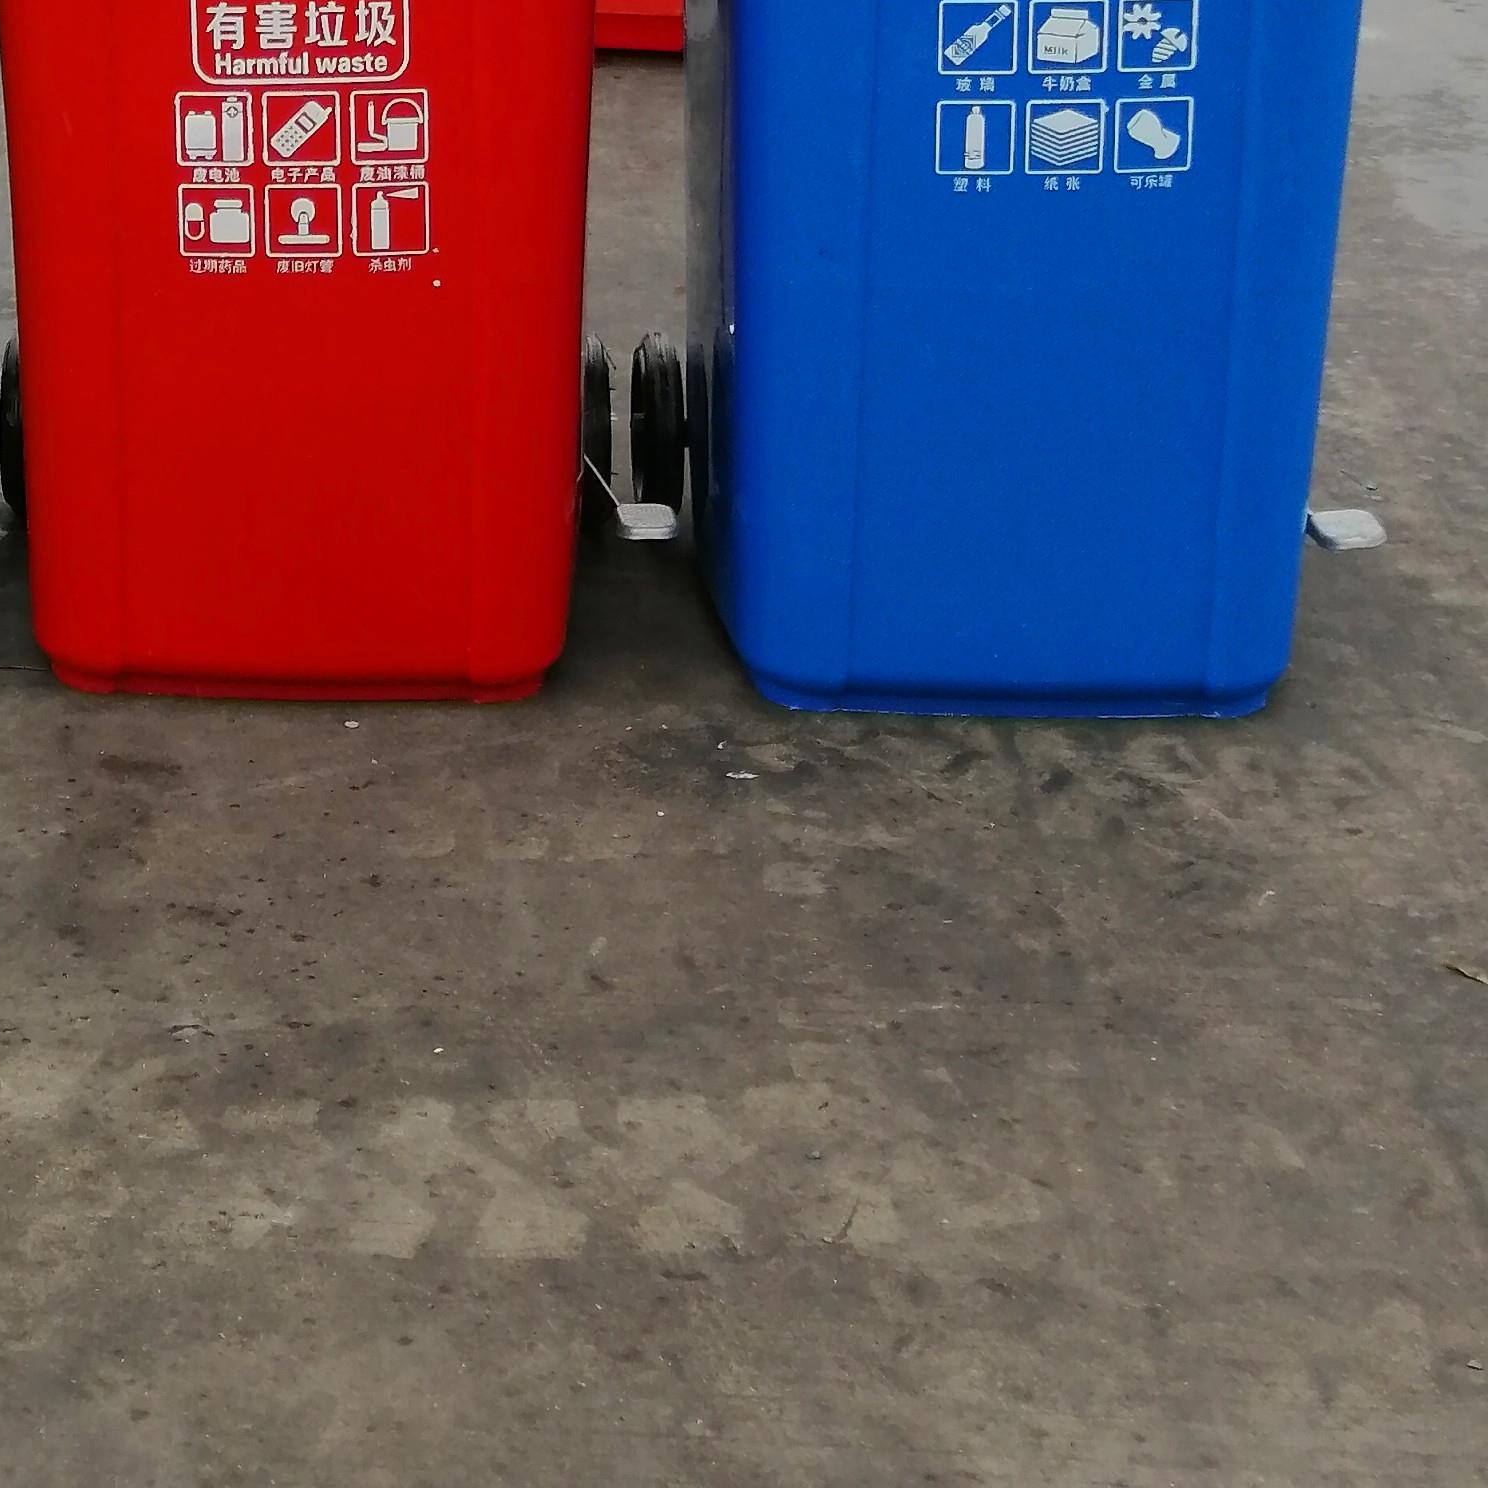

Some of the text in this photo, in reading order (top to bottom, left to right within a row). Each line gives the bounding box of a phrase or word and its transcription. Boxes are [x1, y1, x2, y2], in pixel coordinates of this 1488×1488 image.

[205, 0, 397, 50] 有害垃圾
[214, 51, 388, 76] Harmful waste
[271, 168, 336, 183] 电子产品
